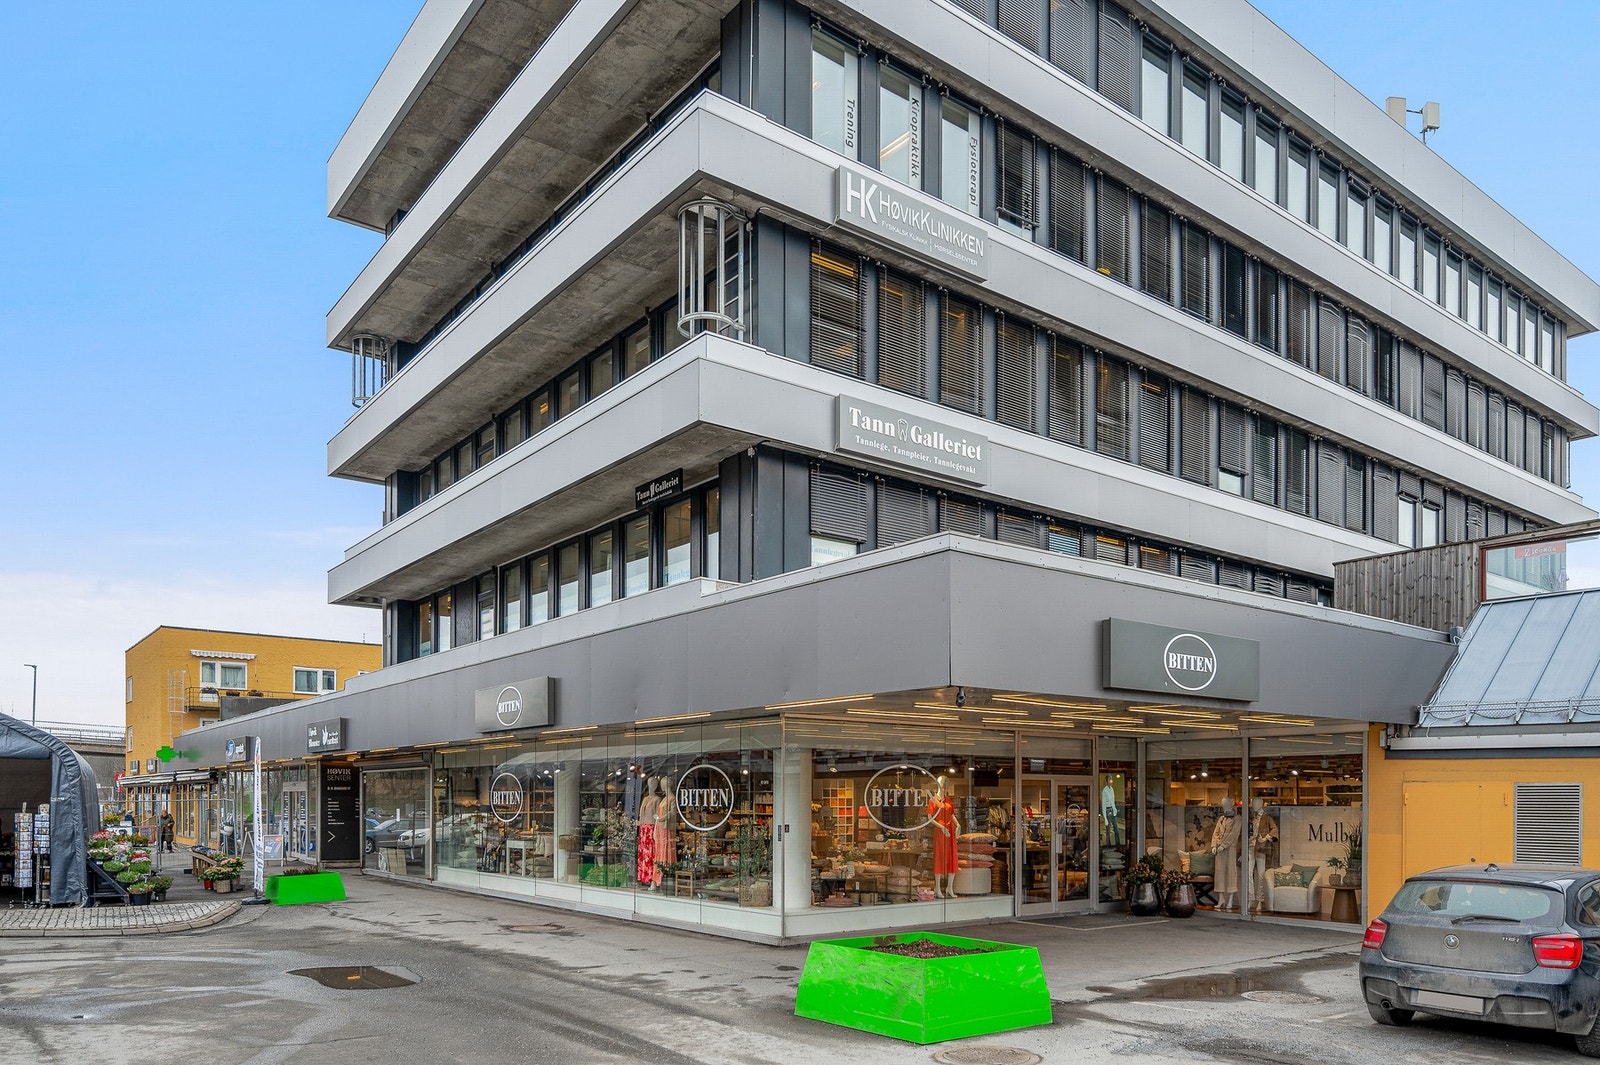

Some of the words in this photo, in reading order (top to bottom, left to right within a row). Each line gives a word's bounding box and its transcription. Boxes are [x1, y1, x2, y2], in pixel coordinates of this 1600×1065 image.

[846, 99, 856, 148] Trening
[910, 97, 920, 178] Kiropraktikk
[969, 136, 979, 207] Fysioterapi
[846, 171, 878, 224] HK
[848, 406, 896, 438] Tann
[910, 424, 982, 461] Galleriet
[933, 456, 976, 474] Tannlegevakt
[636, 490, 650, 501] Tann
[654, 476, 679, 493] Galleriet
[1168, 652, 1213, 673] BITTEN
[498, 700, 521, 714] BITTEN
[493, 790, 521, 805] BITTEN
[680, 788, 730, 807] BITTEN
[871, 788, 937, 807] BITTEN
